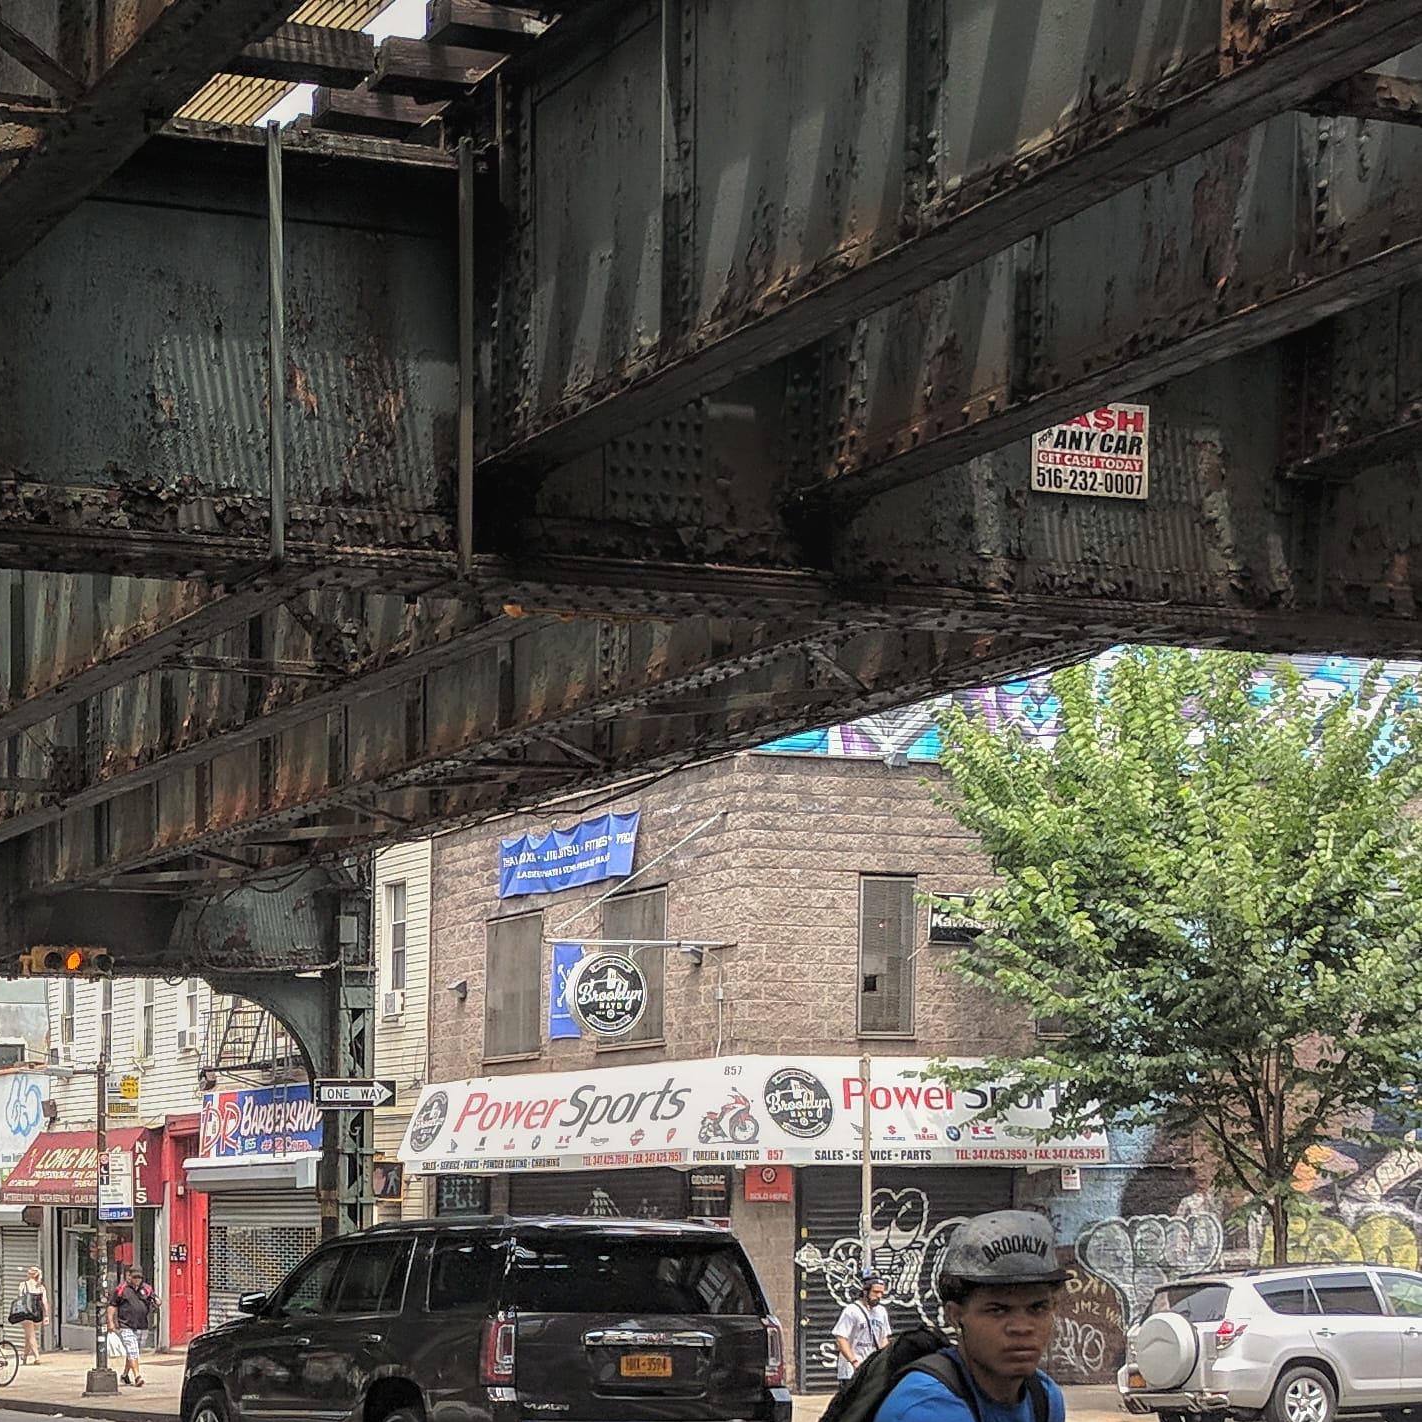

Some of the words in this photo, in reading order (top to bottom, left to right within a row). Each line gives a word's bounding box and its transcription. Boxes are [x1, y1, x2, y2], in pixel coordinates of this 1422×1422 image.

[1038, 429, 1054, 446] FOR
[1054, 430, 1098, 452] ANY
[1099, 433, 1143, 455] CAR
[1039, 452, 1062, 463] GET
[1064, 454, 1096, 467] CASH
[1100, 458, 1142, 471] TODAY
[1036, 467, 1143, 495] 516-232-0007
[577, 978, 642, 1011] Brooklyn
[724, 1066, 742, 1075] 857
[327, 1088, 349, 1099] ONE
[361, 1089, 384, 1099] WAY
[765, 1089, 830, 1118] Brooklyn
[842, 1078, 953, 1109] Power
[35, 1149, 77, 1168] LONG
[693, 1151, 718, 1161] FOREIGN
[727, 1151, 759, 1160] DOMESTIC
[767, 1150, 784, 1161] 857
[814, 1150, 844, 1161] SALES
[852, 1150, 893, 1161] SEVICE
[900, 1149, 932, 1161] PARTS
[134, 1141, 148, 1204] NAILS
